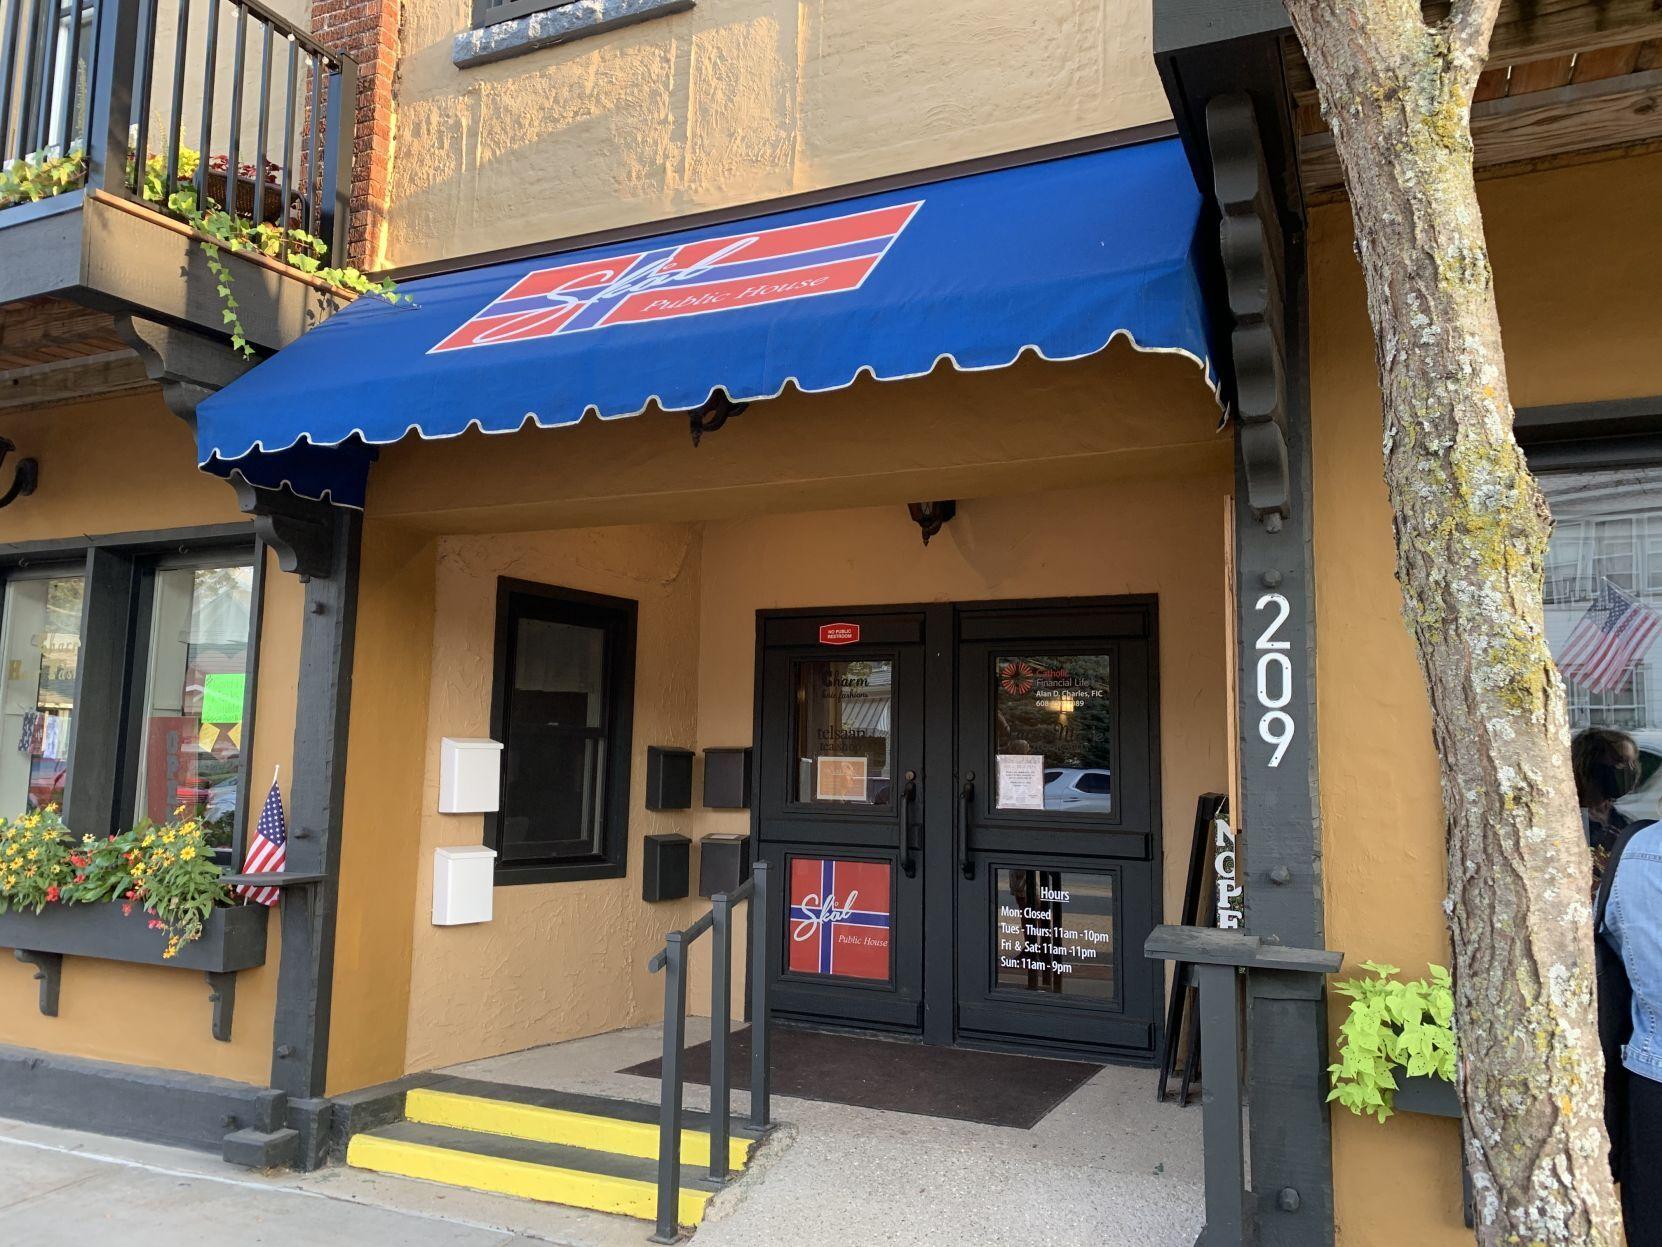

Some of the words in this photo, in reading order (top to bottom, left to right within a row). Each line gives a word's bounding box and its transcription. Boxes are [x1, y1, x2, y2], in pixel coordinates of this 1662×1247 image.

[641, 290, 729, 314] Public
[735, 275, 829, 301] House
[822, 670, 870, 688] Charm
[1036, 668, 1068, 678] Catholic
[1255, 593, 1295, 767] 209
[1036, 678, 1072, 687] Financial
[1074, 678, 1089, 687] Life
[1036, 690, 1052, 698] Alan
[1053, 690, 1060, 698] D.
[1061, 690, 1090, 699] Charles,
[1040, 886, 1070, 901] Hours
[1001, 905, 1022, 917] Mon:
[1024, 907, 1051, 920] Closed
[1001, 922, 1020, 934] Tues
[1026, 924, 1052, 937] Thurs:
[1053, 927, 1078, 940] 11am
[838, 935, 862, 945] Public
[863, 937, 889, 947] House
[1001, 939, 1012, 951] Fri
[1014, 942, 1022, 952] &
[1024, 941, 1041, 953] Sat:
[1042, 943, 1067, 956] 11am
[1000, 955, 1020, 968] Sun:
[1021, 958, 1046, 971] 11am
[1052, 961, 1072, 974] 9pm
